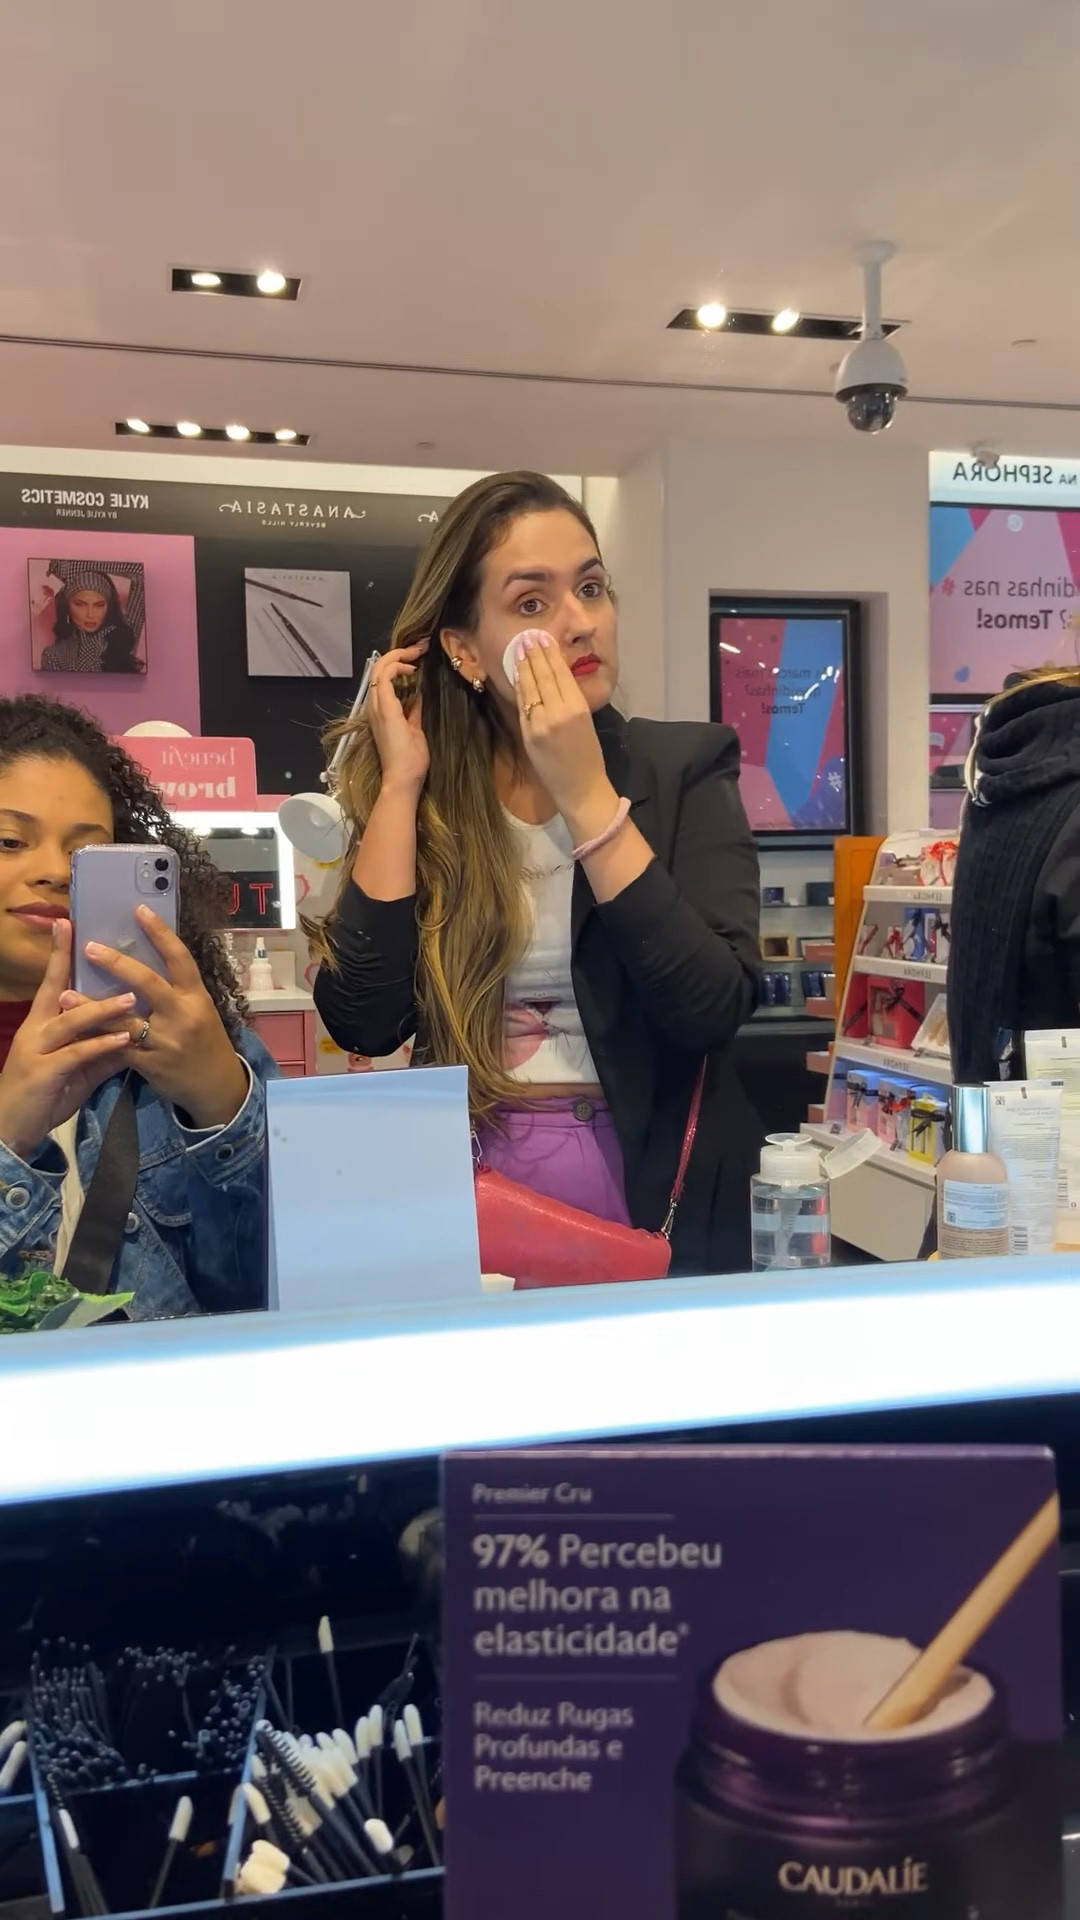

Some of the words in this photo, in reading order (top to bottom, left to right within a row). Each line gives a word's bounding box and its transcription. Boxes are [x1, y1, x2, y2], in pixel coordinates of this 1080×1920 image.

[472, 1483, 551, 1504] Premier
[554, 1483, 593, 1502] Cru
[472, 1533, 550, 1568] 97%
[559, 1534, 722, 1568] Percebeu
[473, 1578, 619, 1612] melhora
[630, 1586, 671, 1612] na
[474, 1702, 551, 1728] Reduz
[558, 1702, 634, 1732] Rugas
[474, 1734, 600, 1759] Profundas
[606, 1740, 624, 1759] e
[474, 1766, 593, 1791] Preenche
[778, 1857, 929, 1896] CAUDALÍE
